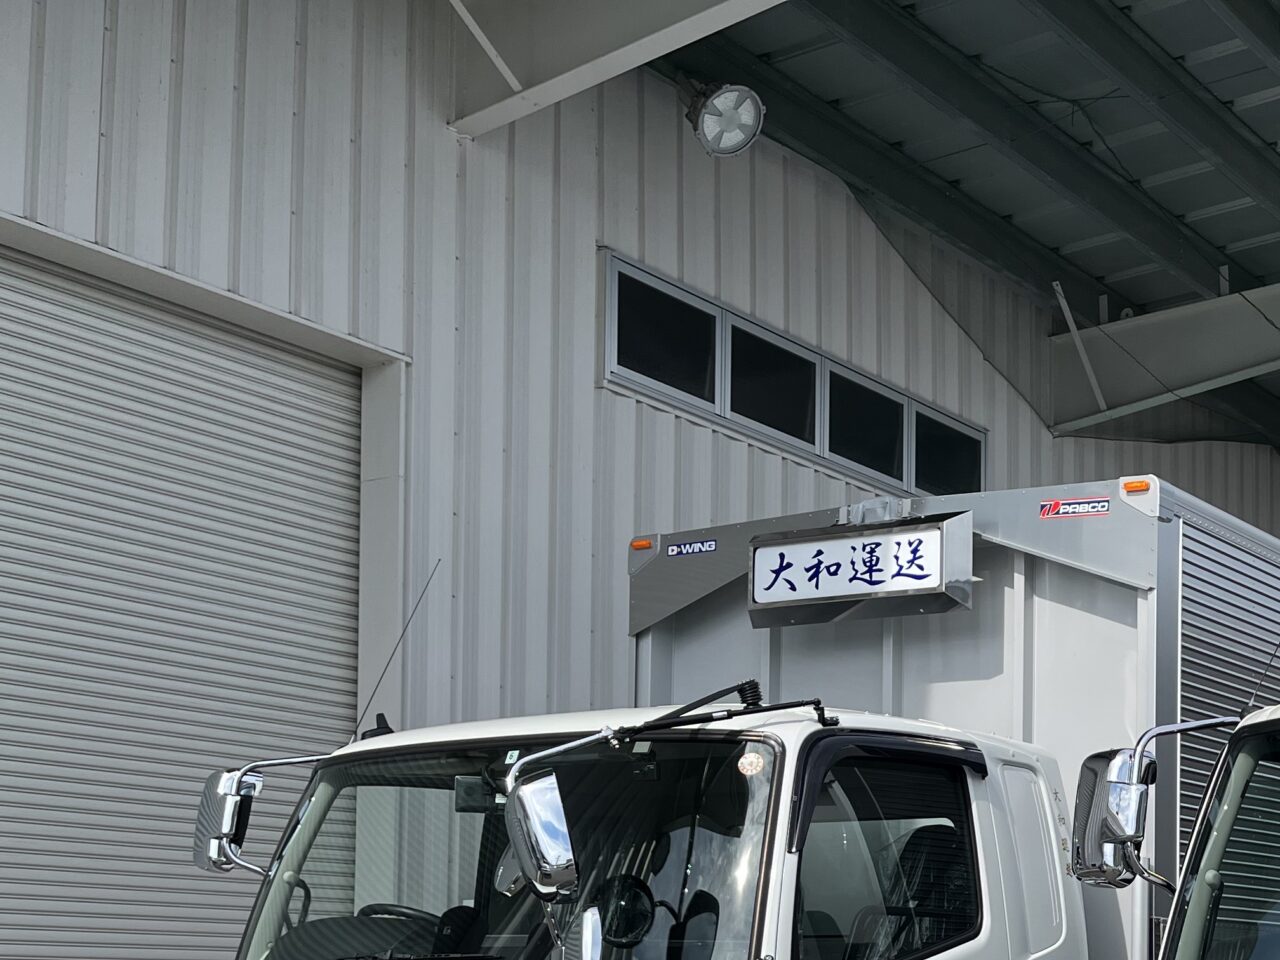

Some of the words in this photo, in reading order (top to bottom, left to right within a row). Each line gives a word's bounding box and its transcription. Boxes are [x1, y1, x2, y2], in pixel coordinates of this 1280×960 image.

[1060, 502, 1108, 514] PABCO
[763, 538, 932, 591] 大和運送
